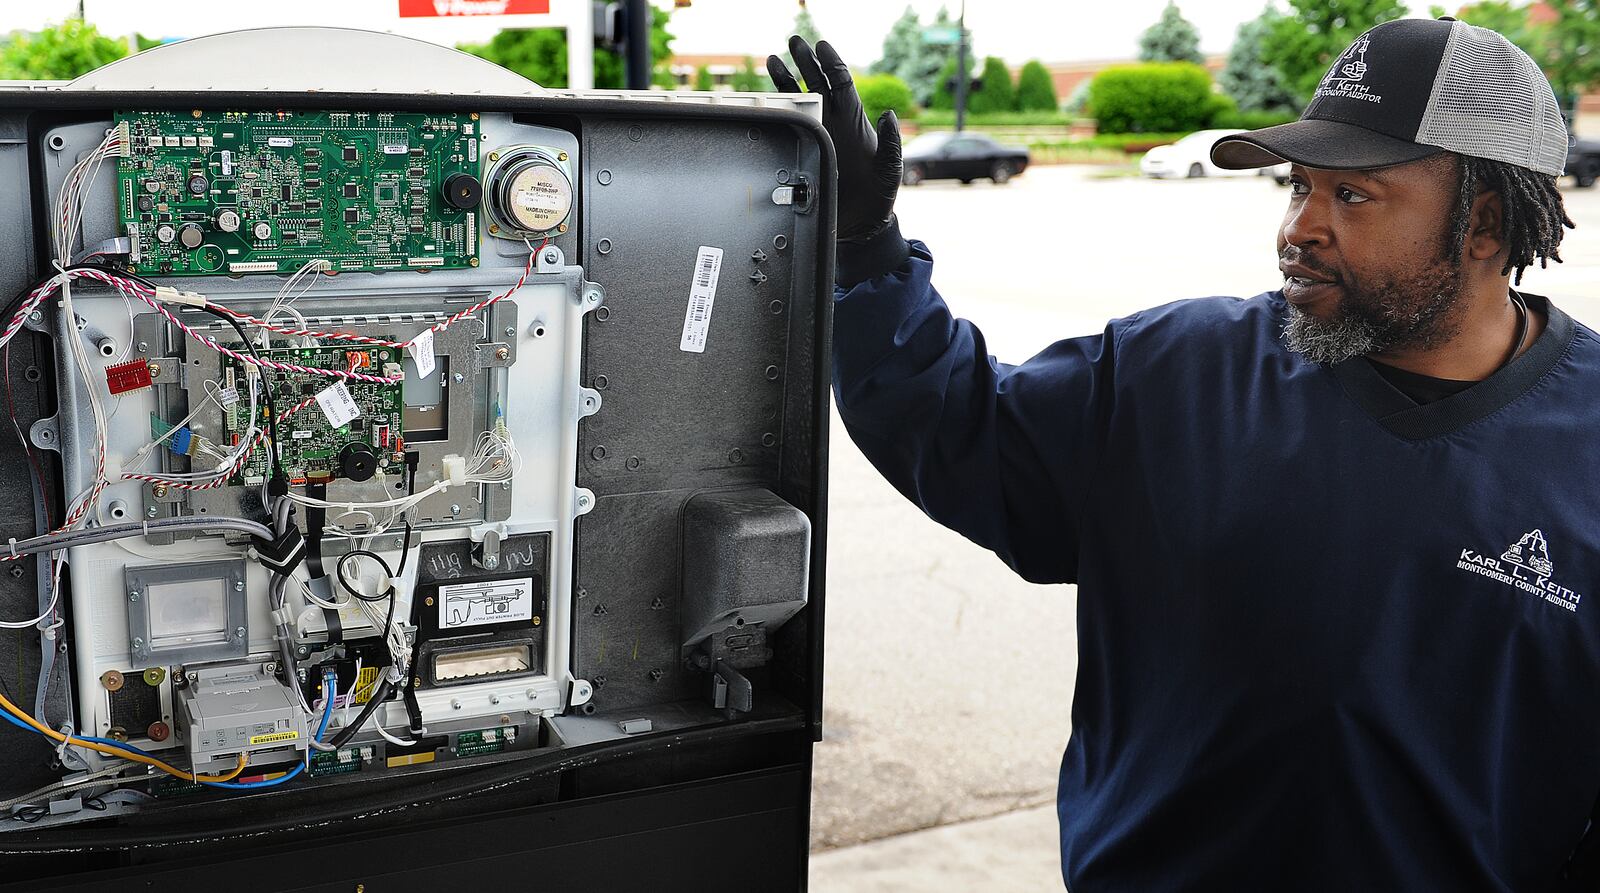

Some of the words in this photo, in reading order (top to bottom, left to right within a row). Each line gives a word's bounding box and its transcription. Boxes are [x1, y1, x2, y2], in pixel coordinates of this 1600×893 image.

[1346, 91, 1382, 104] AUDITOR
[1456, 560, 1515, 587] MONTGOMERY
[1514, 579, 1548, 599] COUNTY
[1544, 593, 1577, 612] AUDITOR
[1460, 548, 1505, 573] KARL
[1512, 565, 1528, 581] L.
[1535, 575, 1581, 604] KEITH
